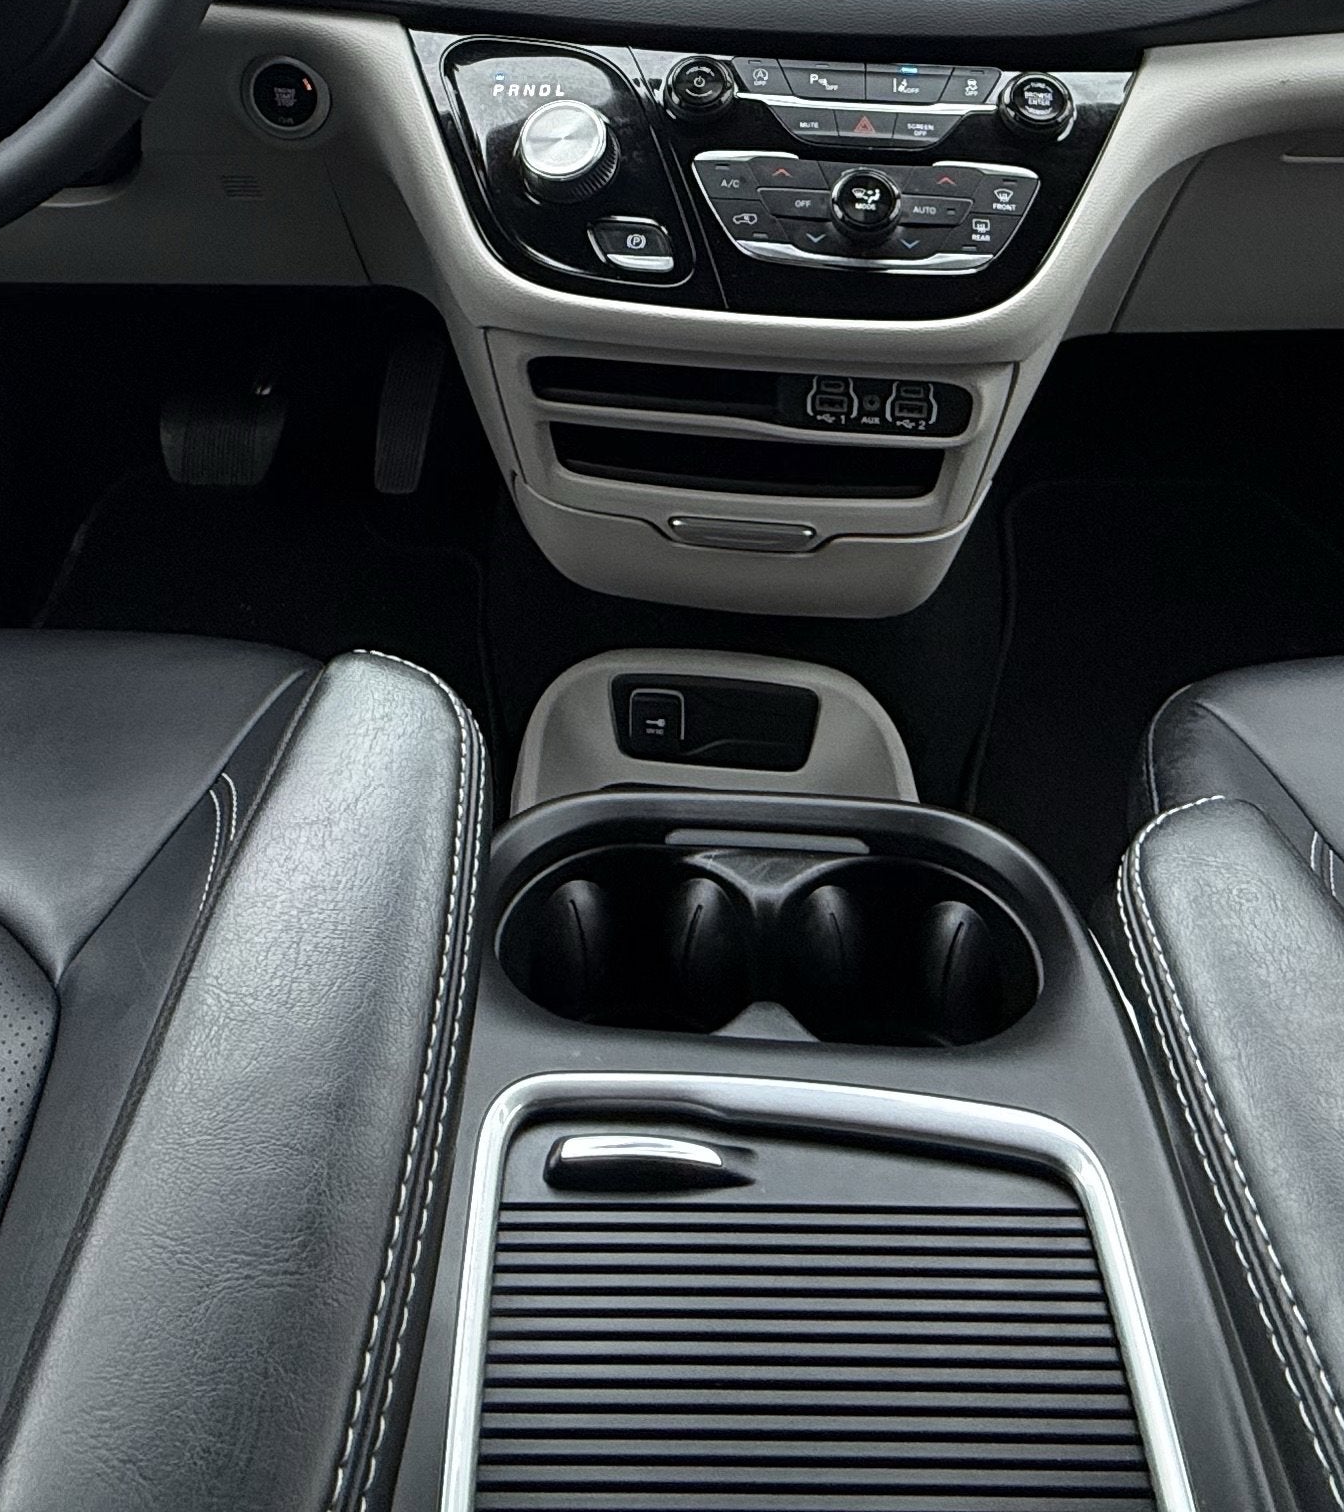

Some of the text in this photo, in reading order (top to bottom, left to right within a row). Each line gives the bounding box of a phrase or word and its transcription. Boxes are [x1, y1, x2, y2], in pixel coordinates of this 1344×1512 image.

[964, 89, 979, 97] OFF
[799, 121, 819, 129] MUTE
[913, 129, 928, 137] OFF
[721, 179, 740, 188] A/C
[794, 200, 812, 209] OFF
[854, 203, 877, 211] MODE
[992, 203, 1017, 212] FRONT
[912, 206, 937, 215] AUTO
[971, 234, 991, 242] REAR
[840, 415, 846, 425] 1
[860, 416, 880, 425] AUX
[918, 420, 926, 430] 2
